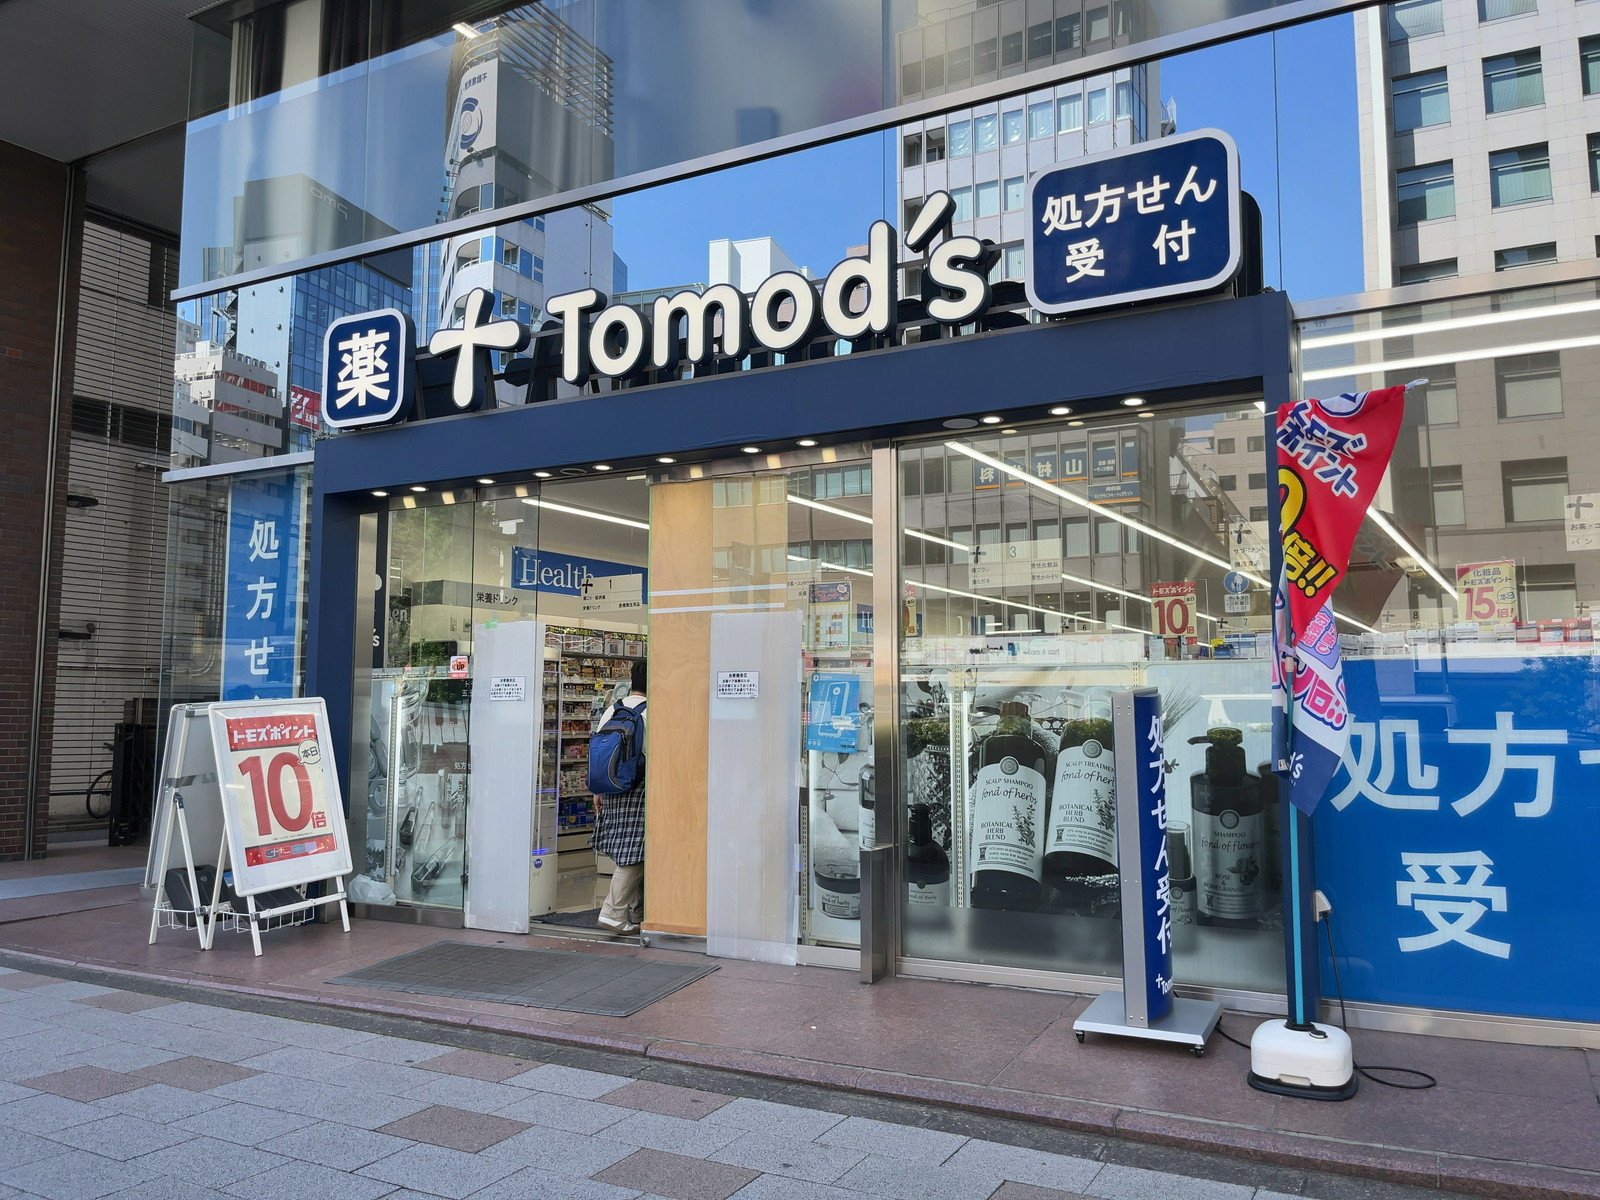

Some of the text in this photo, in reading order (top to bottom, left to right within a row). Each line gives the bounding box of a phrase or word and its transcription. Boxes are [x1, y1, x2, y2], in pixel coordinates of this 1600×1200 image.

[1042, 165, 1217, 236] 処方せん
[546, 190, 990, 384] Tomod's
[335, 329, 390, 409] 薬
[1276, 420, 1357, 495] ポイント
[1571, 537, 1593, 545] パン
[1009, 545, 1017, 559] 3
[1030, 561, 1059, 569] 男性化粧品
[1472, 567, 1501, 578] 化粧品
[608, 579, 613, 590] 1
[1463, 576, 1512, 587] トモズポイント
[244, 520, 280, 700] 処方せ
[1463, 586, 1496, 621] 15
[1412, 610, 1419, 620] 8
[232, 723, 315, 744] トモズポイント
[301, 745, 319, 760] 本日
[1065, 760, 1084, 768] SCALP
[1329, 711, 1600, 818] 処方
[1060, 768, 1083, 783] fond
[1083, 770, 1097, 782] of
[985, 777, 1034, 790] SCALP SHAMPOO
[238, 751, 327, 837] 10 倍
[981, 786, 1039, 806] fond of herbs
[1058, 803, 1094, 813] BOTANICAL
[980, 821, 1015, 829] BOTANICAL
[1062, 816, 1086, 824] BLEND
[1201, 836, 1220, 848] fond
[1221, 841, 1232, 853] of
[1203, 882, 1244, 893] POMEGRANATE
[1395, 850, 1511, 959] 受
